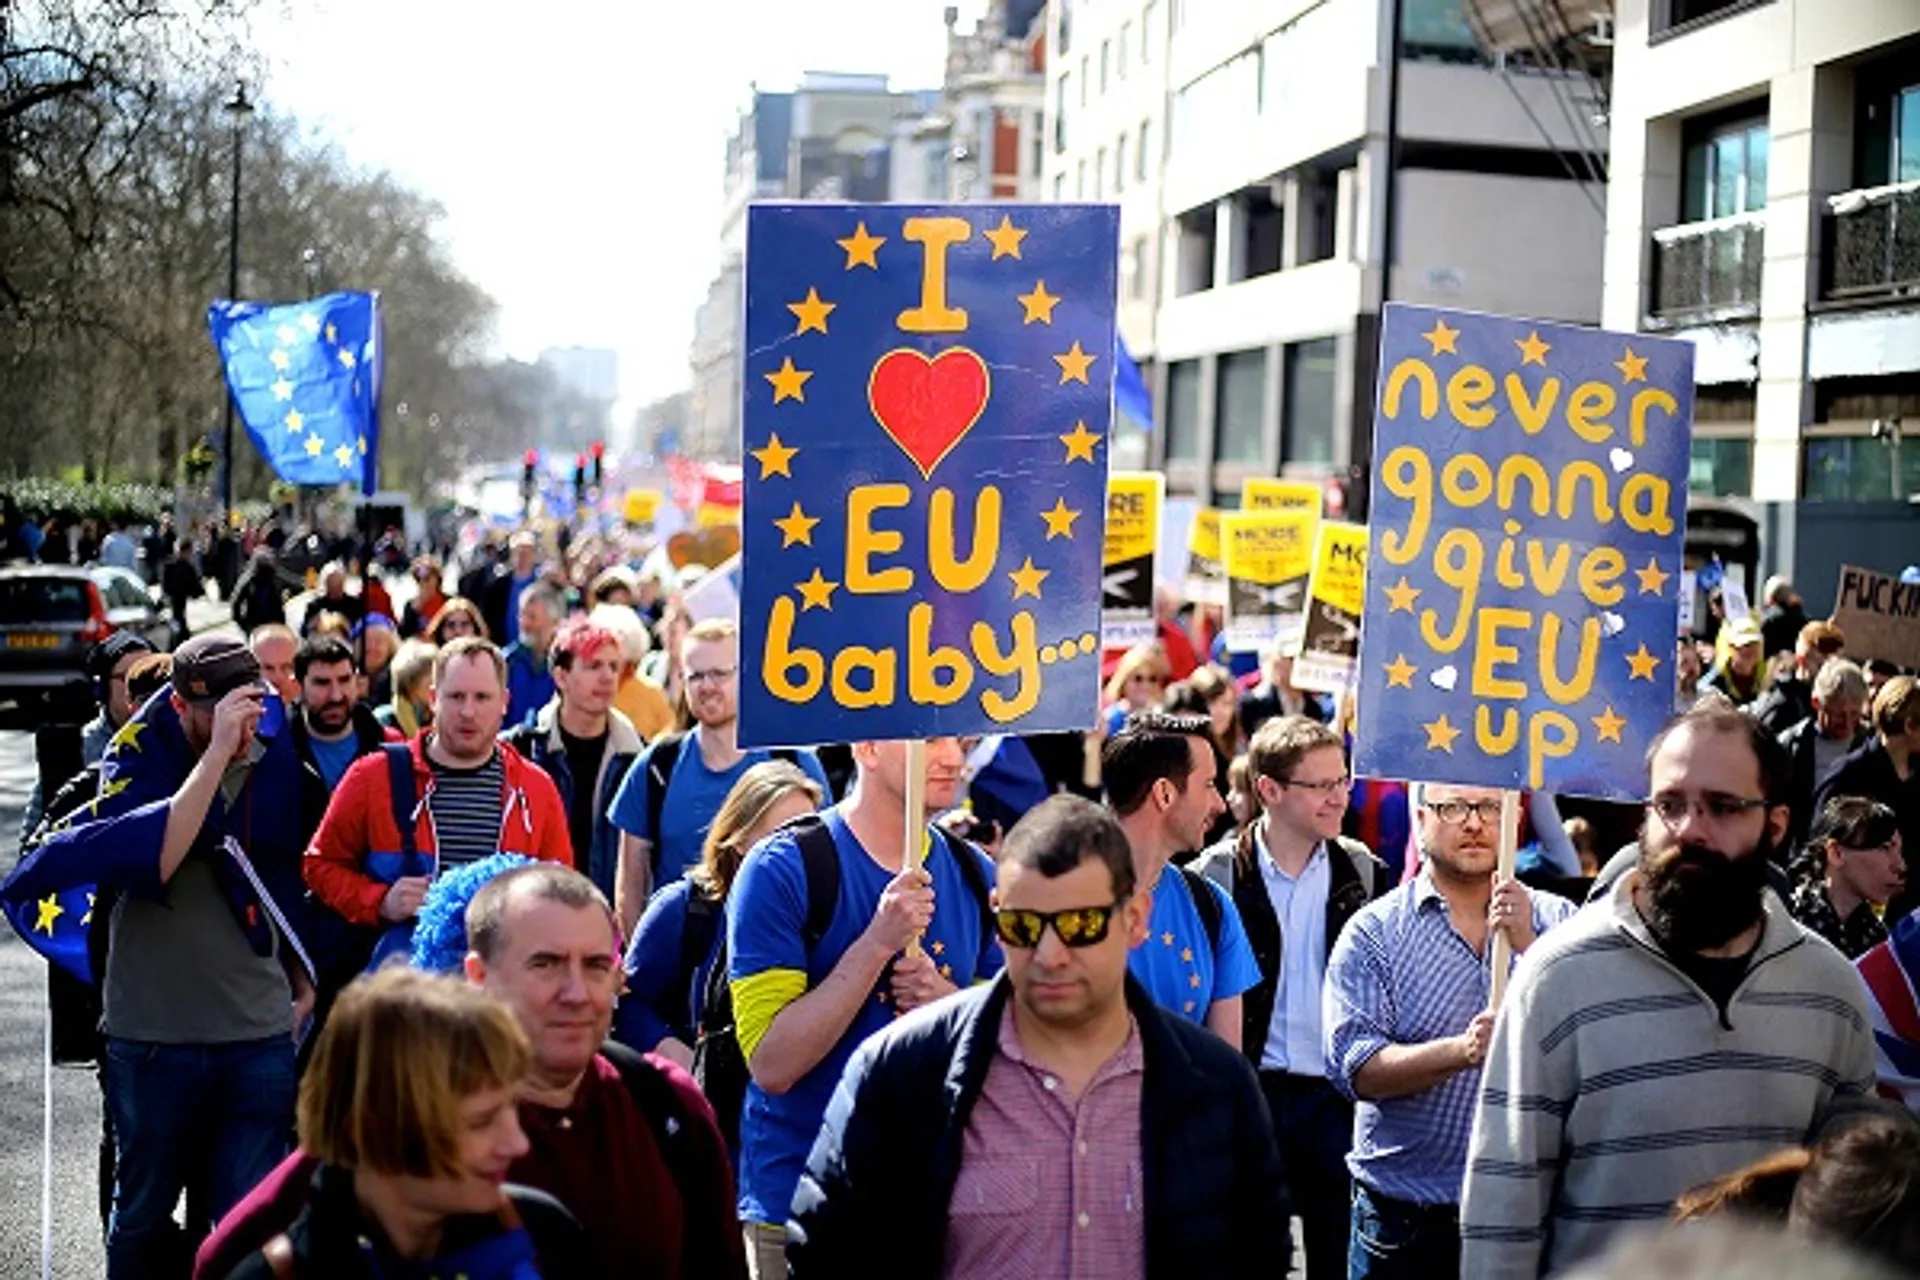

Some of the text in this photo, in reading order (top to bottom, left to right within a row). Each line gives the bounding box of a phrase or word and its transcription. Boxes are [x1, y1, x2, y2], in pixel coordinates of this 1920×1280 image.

[896, 217, 971, 333] I
[1382, 357, 1678, 447] never
[844, 484, 1002, 594] EU
[1381, 446, 1675, 565] gonna
[1420, 518, 1627, 654] give
[761, 596, 1098, 723] baby...
[1471, 607, 1602, 705] EU
[1475, 704, 1579, 790] up
